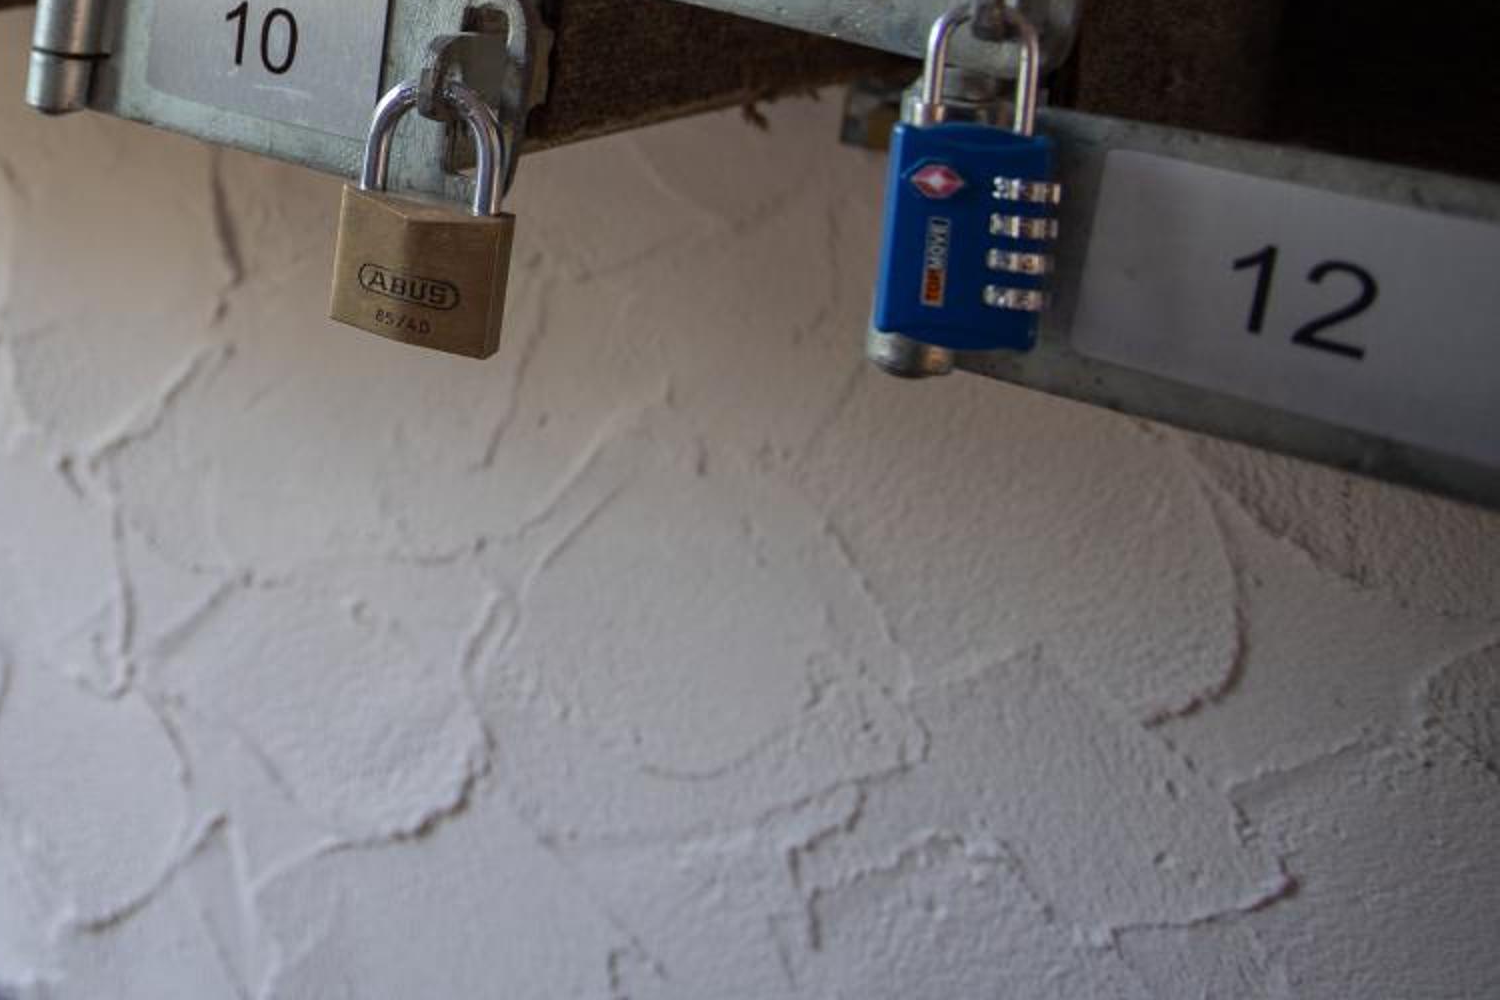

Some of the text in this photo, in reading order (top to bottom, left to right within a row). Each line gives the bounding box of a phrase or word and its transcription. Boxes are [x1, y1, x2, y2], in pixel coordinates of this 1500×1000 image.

[225, 0, 299, 75] 10
[367, 270, 447, 305] ABUS
[1231, 244, 1379, 361] 12
